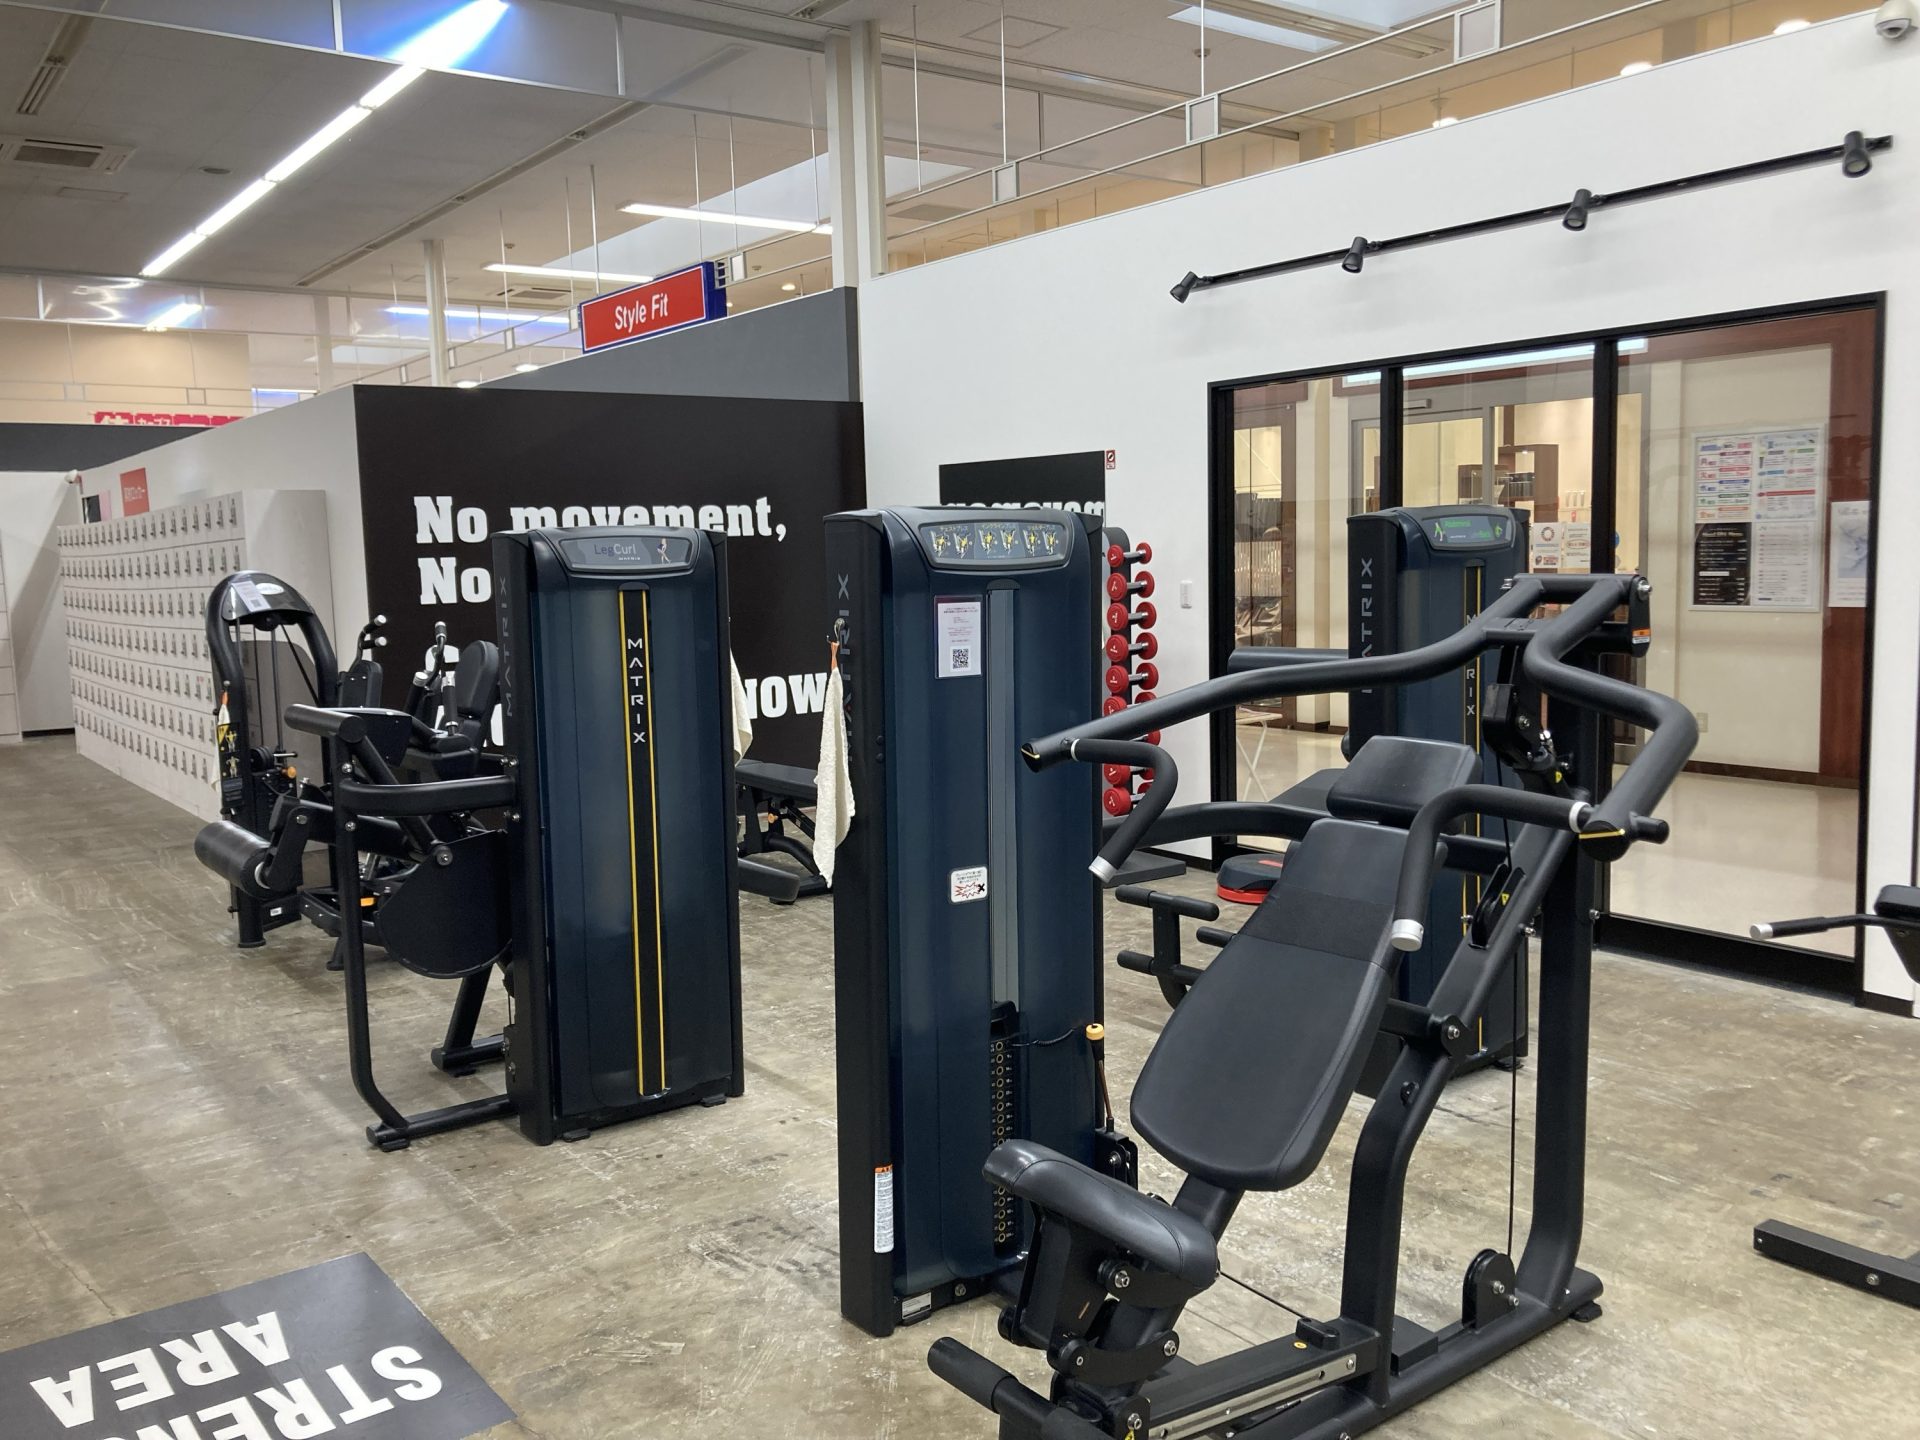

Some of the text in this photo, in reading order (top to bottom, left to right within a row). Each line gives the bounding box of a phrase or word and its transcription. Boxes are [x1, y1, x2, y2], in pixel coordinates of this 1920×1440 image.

[614, 293, 669, 333] Style Fit
[414, 496, 488, 543] No
[418, 557, 491, 604] No
[1361, 558, 1373, 694] ATRIX
[500, 576, 513, 717] MATRIX
[627, 638, 647, 744] MATRIX
[838, 573, 853, 762] ATRIX
[29, 1311, 291, 1429] AREA
